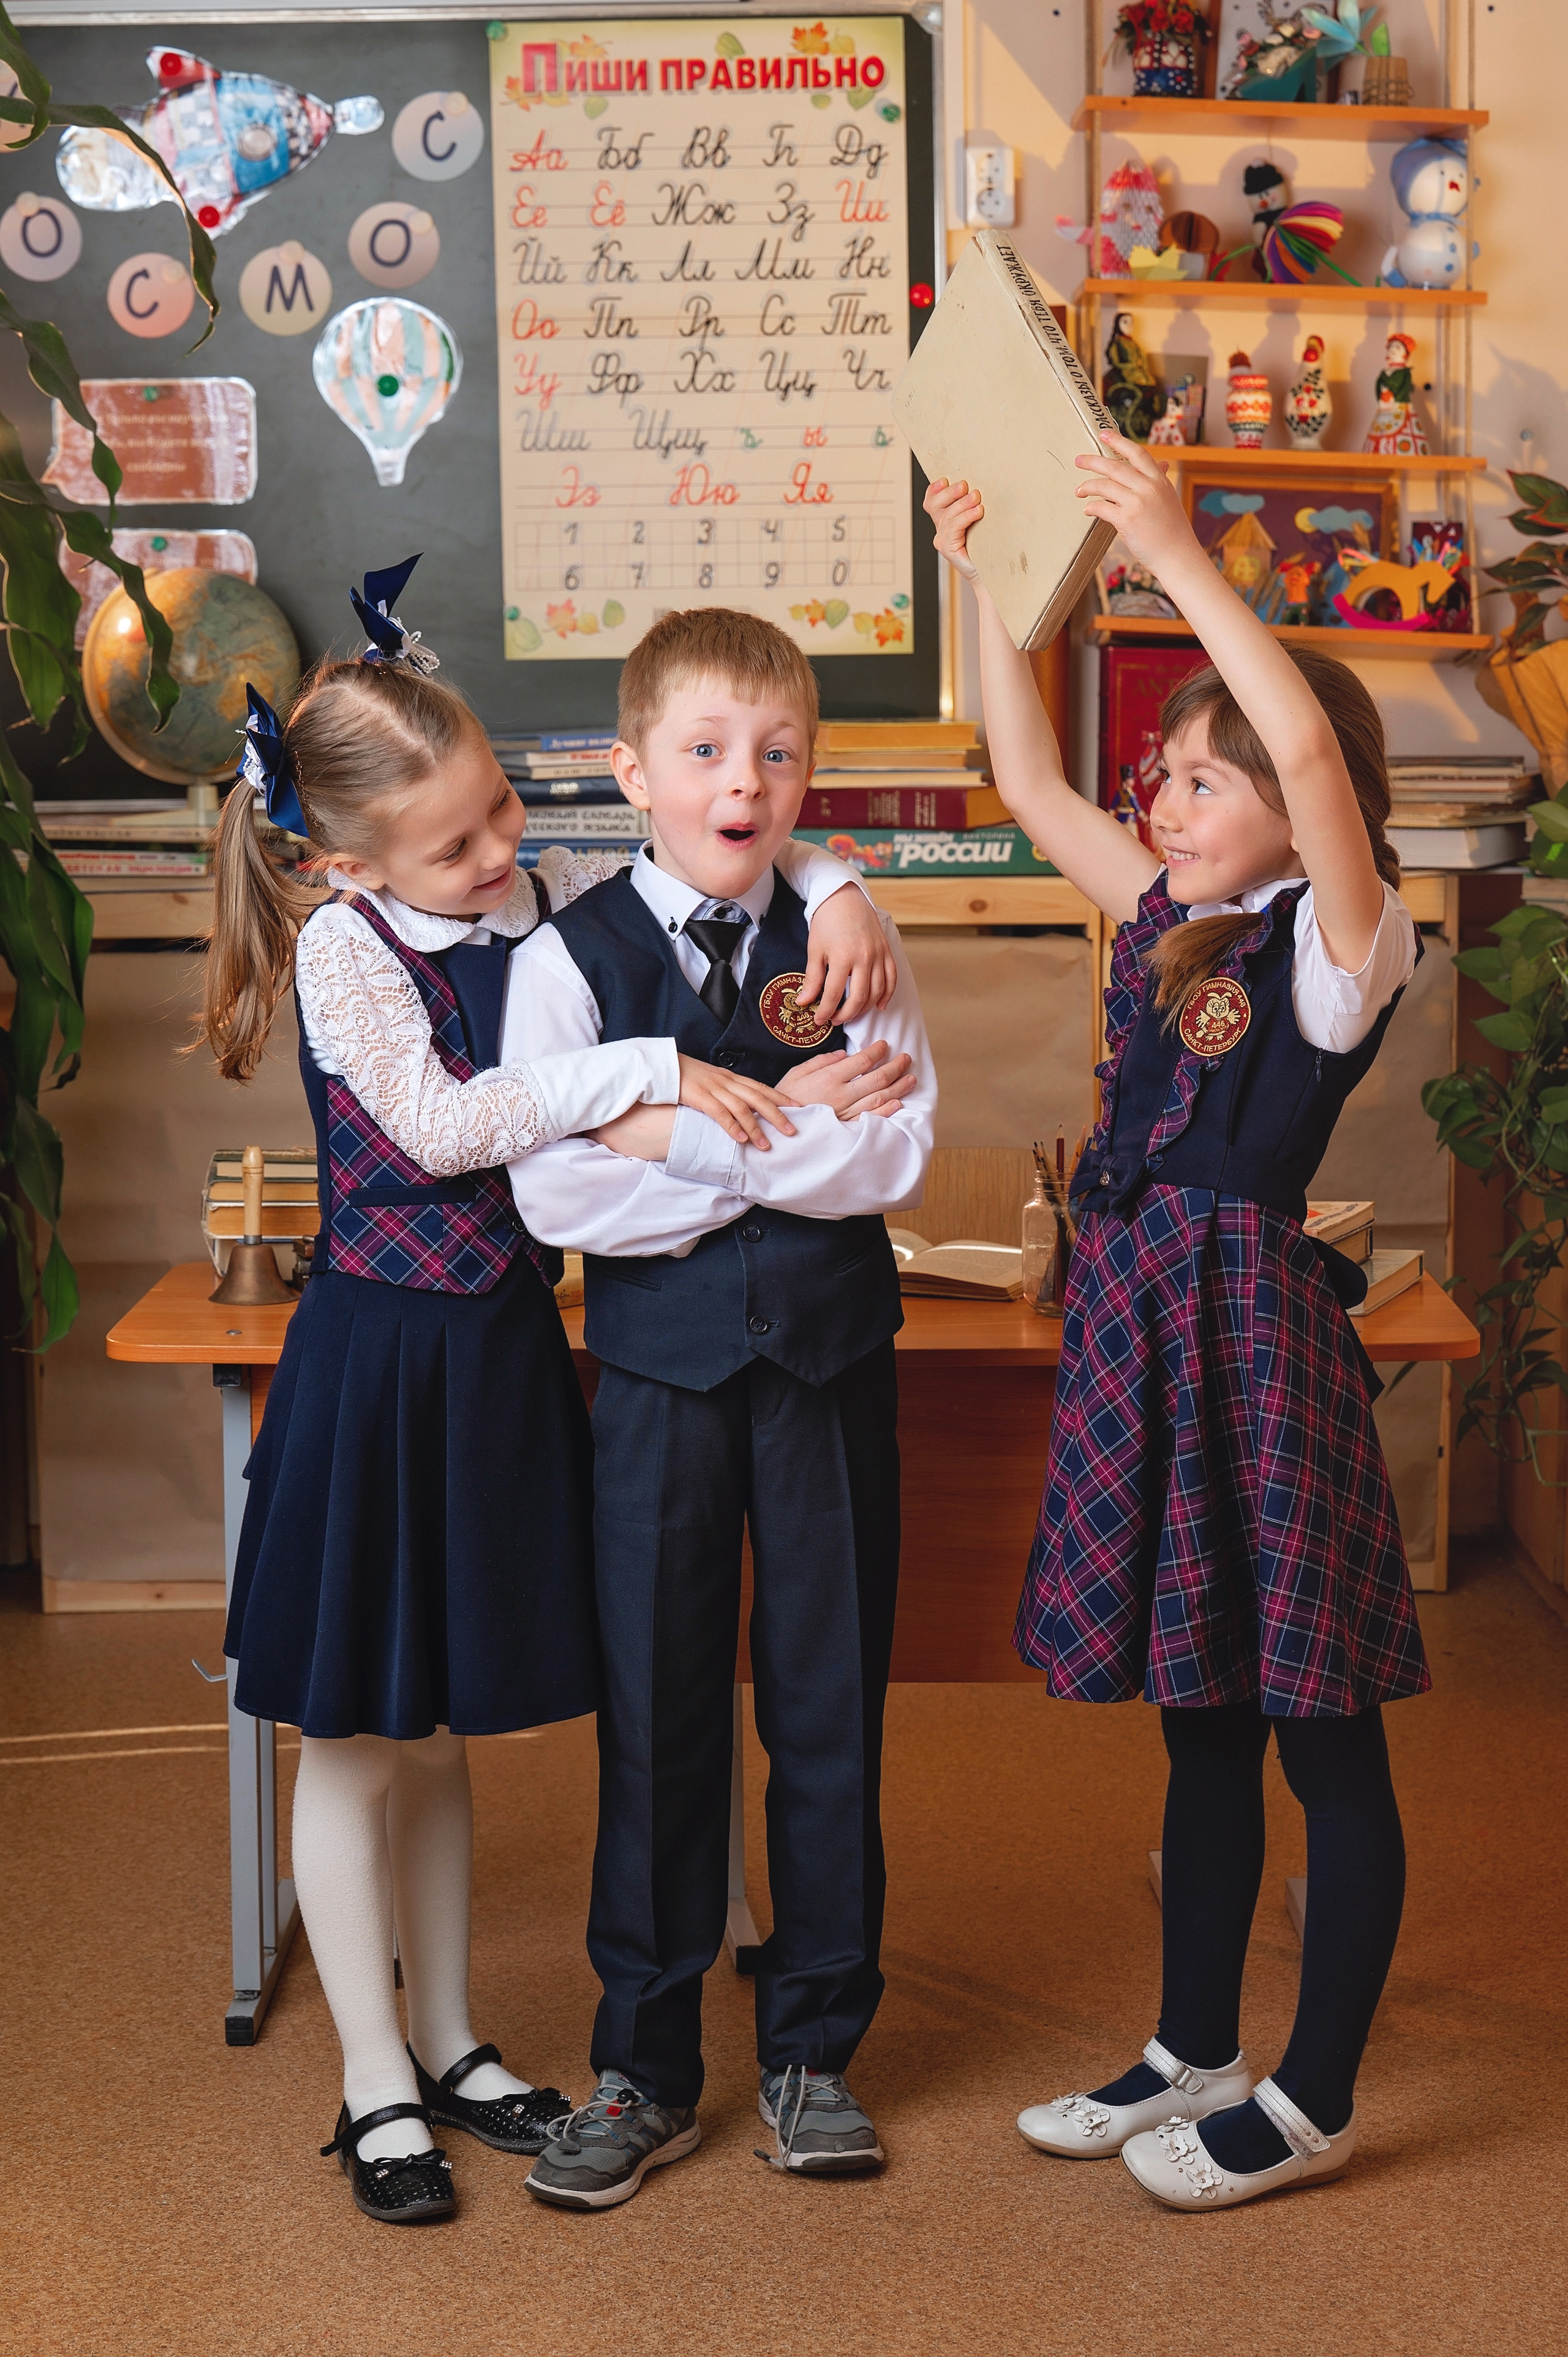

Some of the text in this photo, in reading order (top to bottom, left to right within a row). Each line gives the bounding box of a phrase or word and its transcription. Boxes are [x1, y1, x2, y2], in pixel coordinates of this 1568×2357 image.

[660, 57, 884, 92] ПРАВИЛЬНО
[996, 244, 1036, 296] ОКРУЖАЕТ
[1029, 299, 1052, 322] ТЕБЯ
[1042, 325, 1063, 344] ЧТО
[1074, 380, 1114, 429] РАССКАЗЫ
[564, 516, 846, 545] 1 2 3 4 5
[564, 560, 847, 590] 6 7 8 9 0
[763, 976, 805, 1008] ГБОУ ГИМНАЗ
[1187, 991, 1202, 1009] ГБОУ
[797, 1012, 810, 1021] 446
[1184, 1027, 1242, 1052] САНКТ-ПЕТЕРБУРГ
